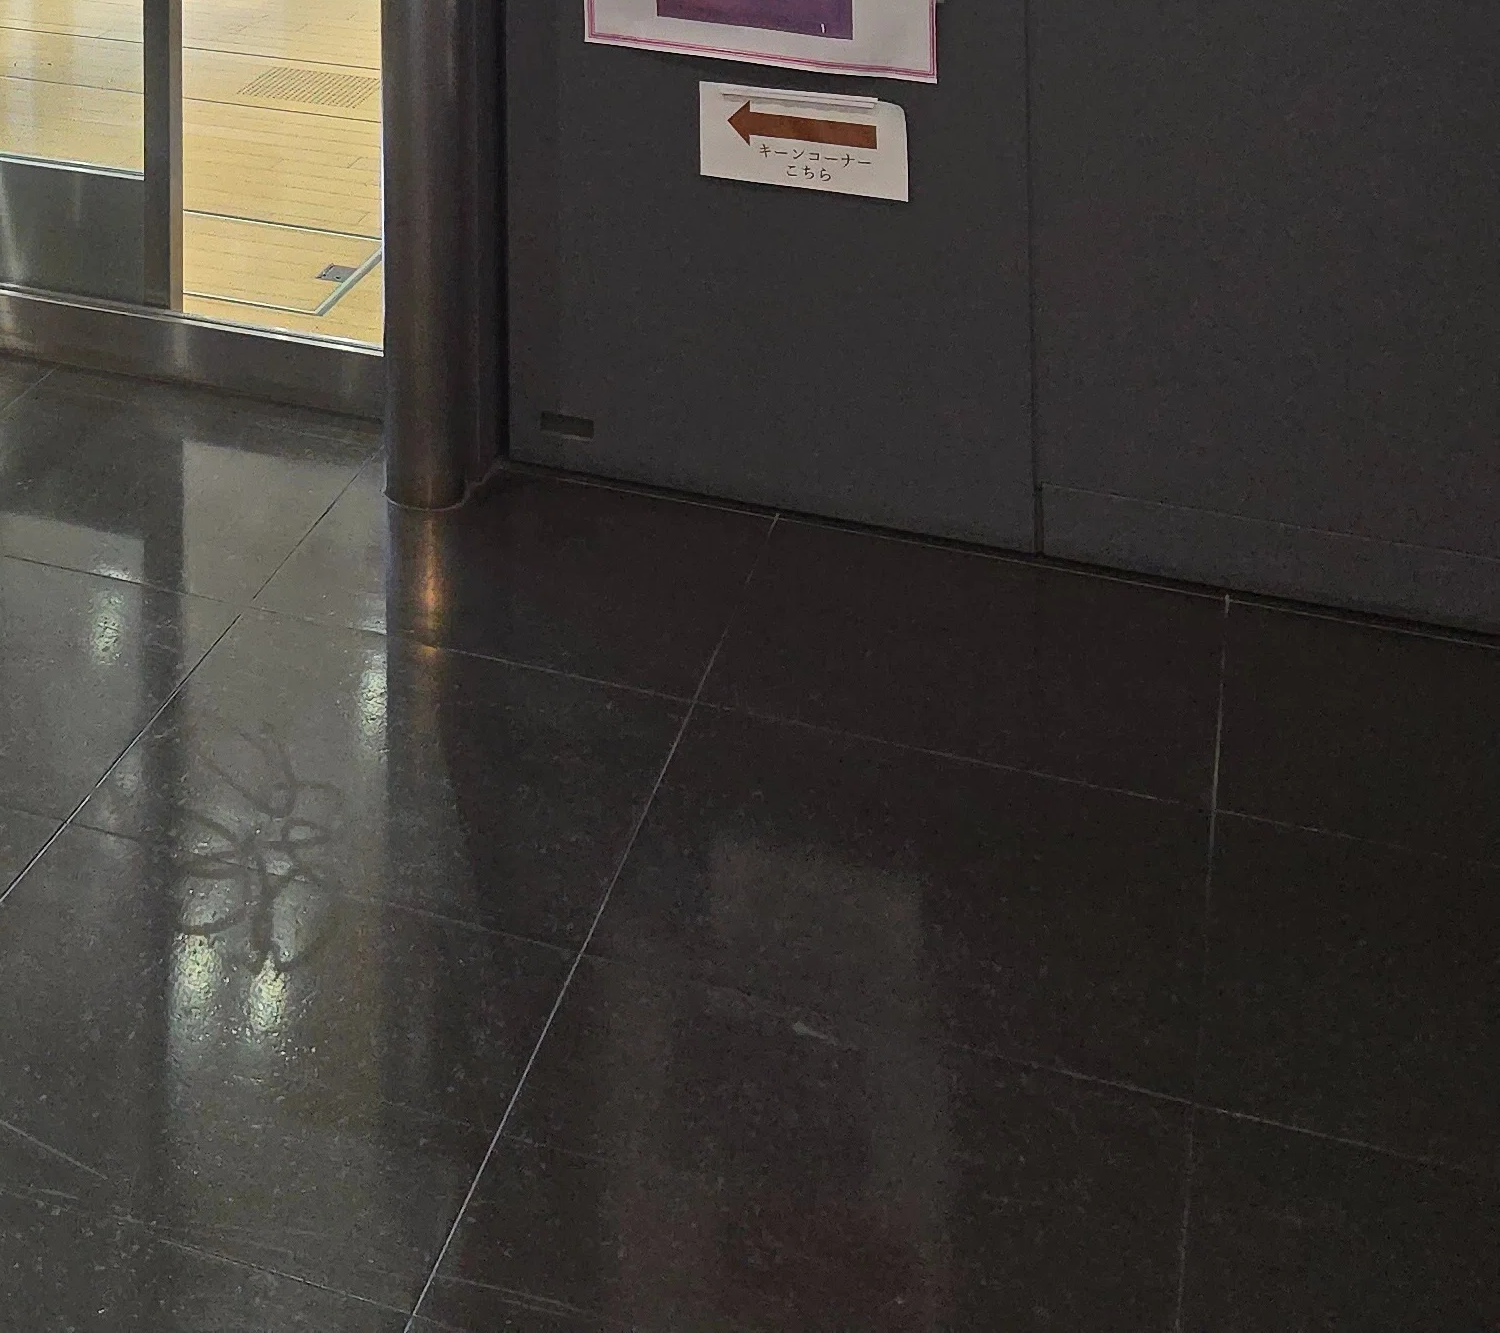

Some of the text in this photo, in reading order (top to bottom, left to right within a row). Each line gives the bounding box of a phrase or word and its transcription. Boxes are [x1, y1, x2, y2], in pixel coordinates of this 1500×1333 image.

[759, 143, 872, 168] キーンコーナー
[786, 165, 832, 182] こちら
